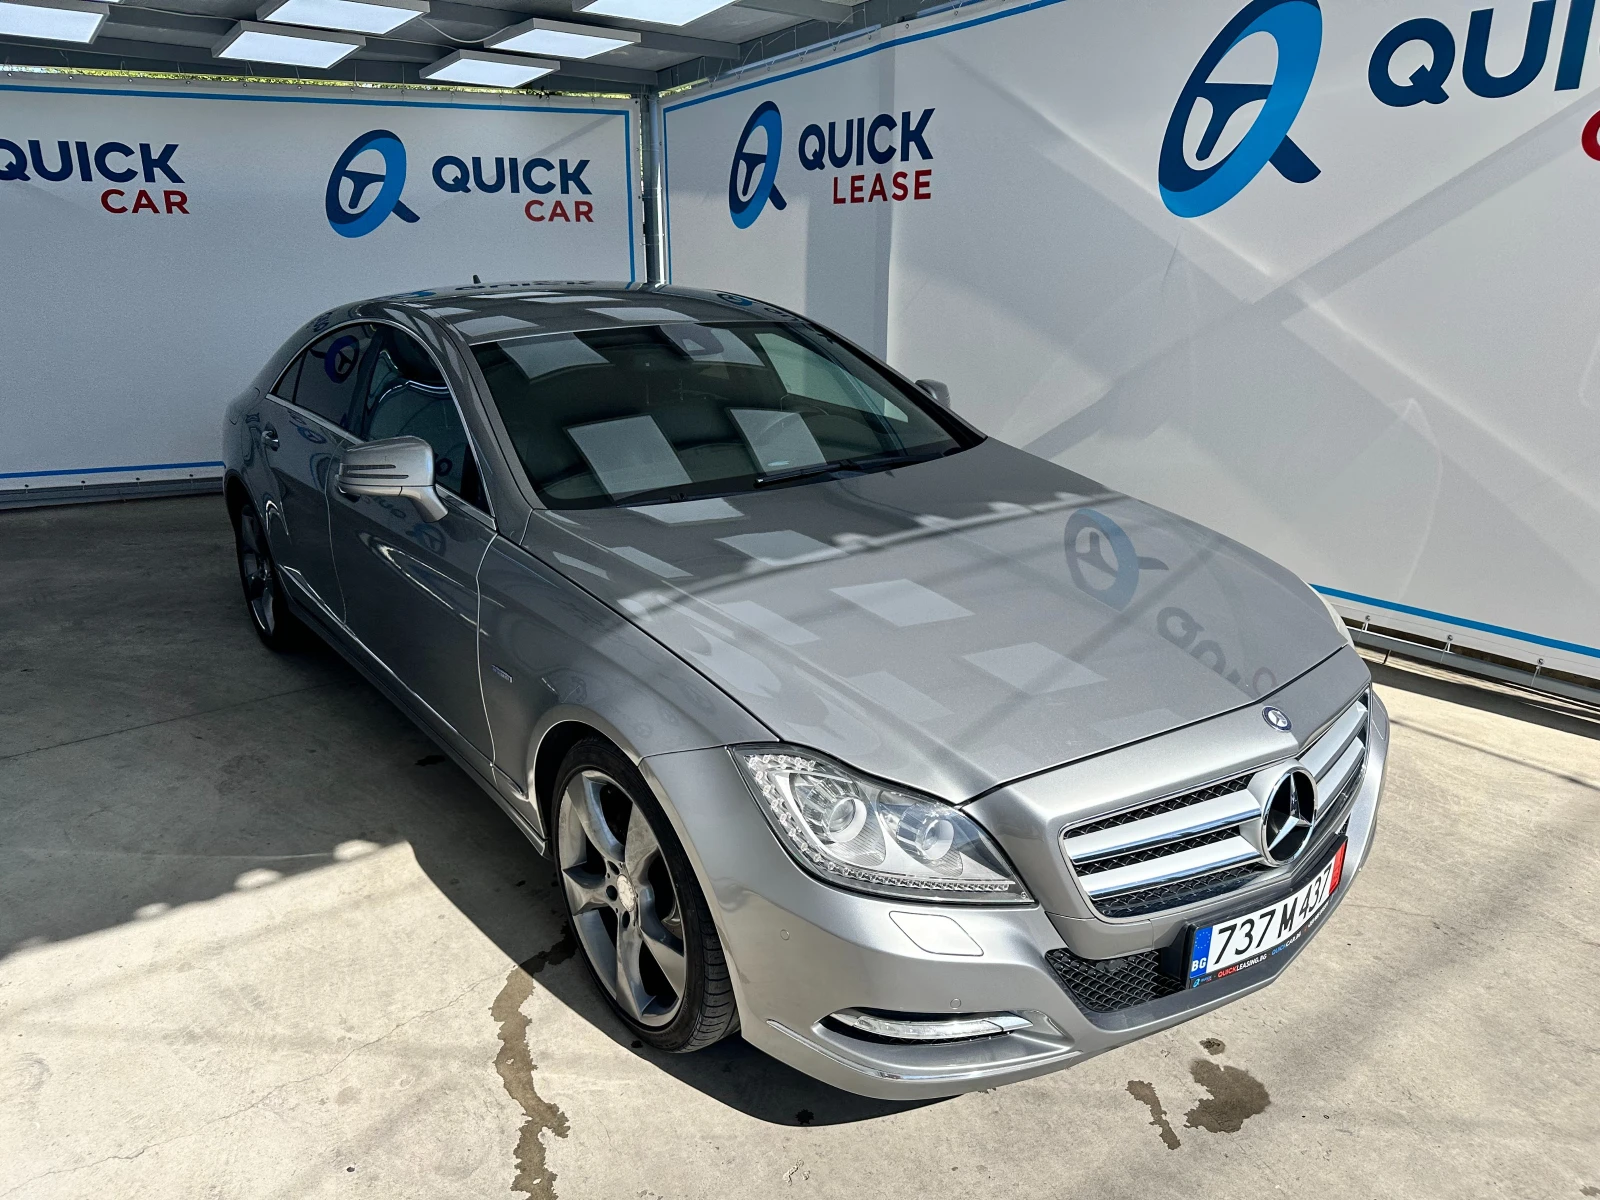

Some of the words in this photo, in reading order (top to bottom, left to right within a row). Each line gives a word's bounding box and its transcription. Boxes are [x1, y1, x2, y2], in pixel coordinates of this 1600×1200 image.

[1368, 0, 1600, 107] QUI
[798, 108, 935, 171] QUICK
[0, 138, 186, 184] QUICK
[432, 155, 593, 195] QUICK
[101, 188, 190, 214] CAR
[833, 169, 932, 205] LEASE
[524, 199, 594, 223] CAR
[1213, 908, 1277, 965] 737
[1277, 897, 1299, 939] M
[1298, 862, 1333, 920] 437
[1191, 957, 1207, 973] BG
